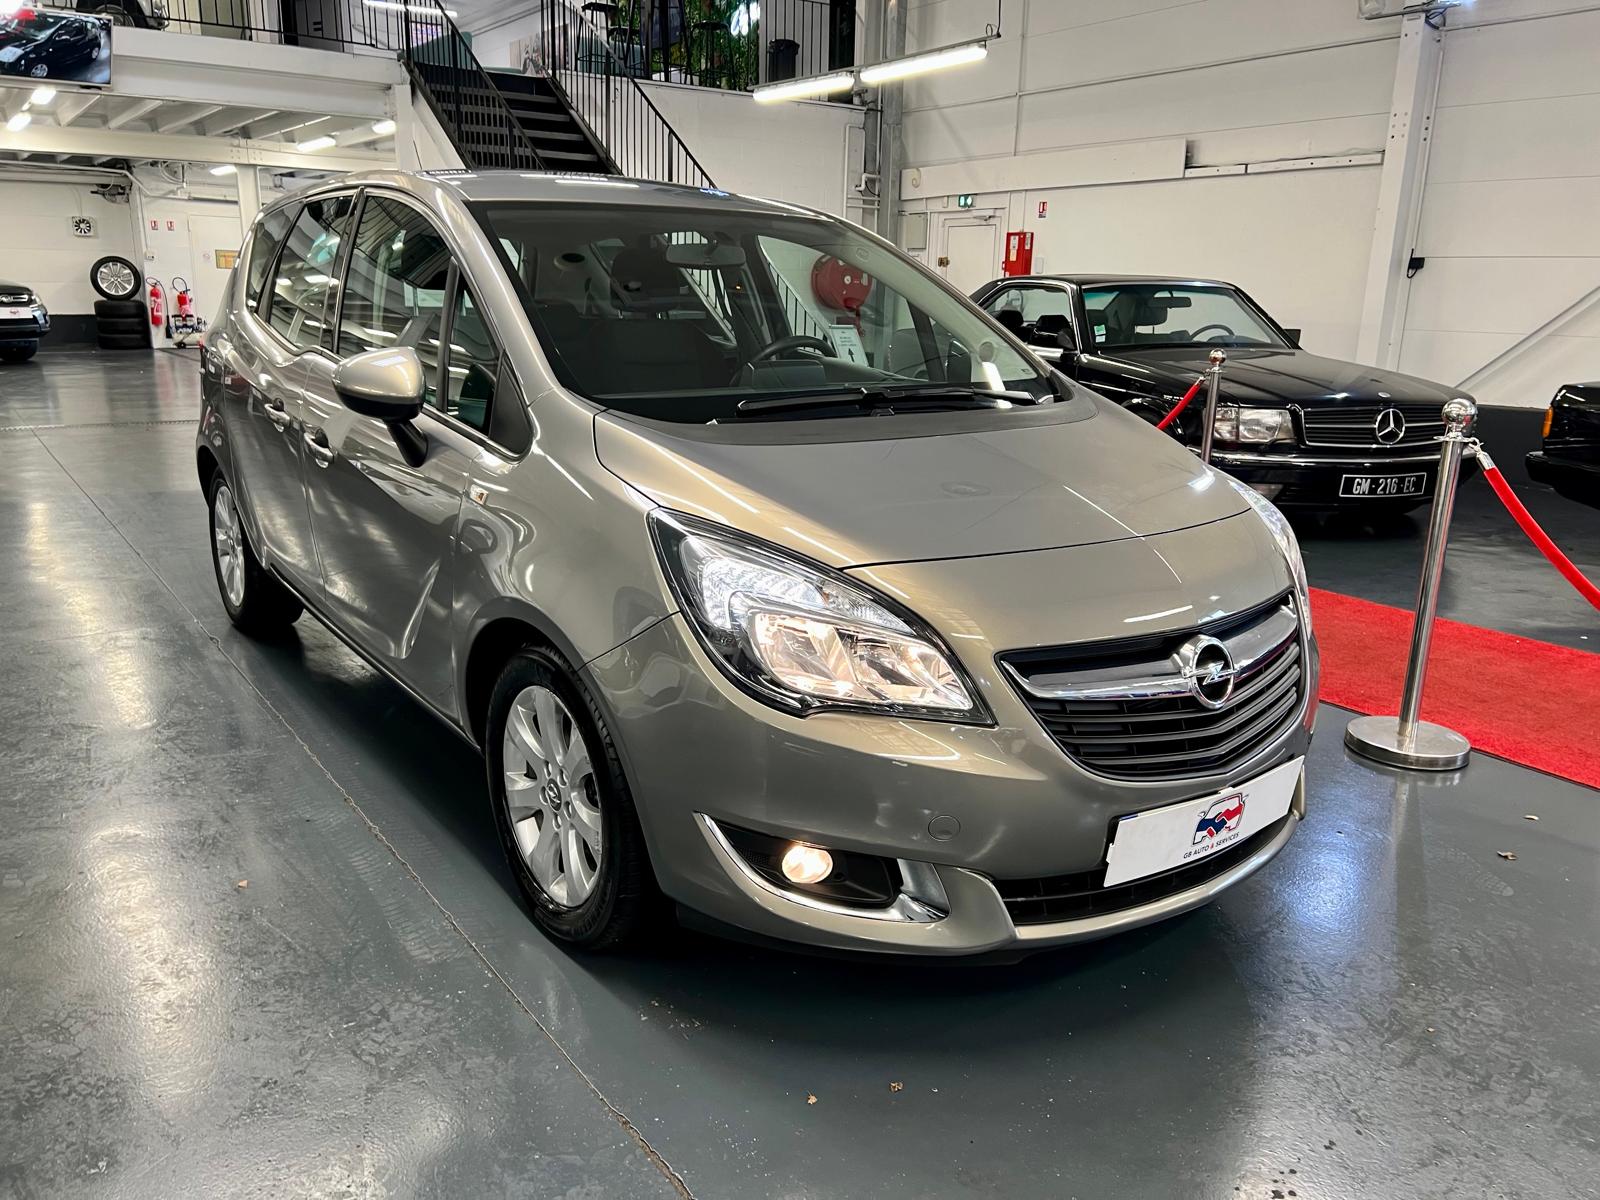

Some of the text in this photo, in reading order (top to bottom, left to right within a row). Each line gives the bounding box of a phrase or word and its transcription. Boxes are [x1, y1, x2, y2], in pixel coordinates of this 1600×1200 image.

[1183, 851, 1192, 859] GB
[1193, 845, 1210, 855] AUTO
[1216, 832, 1240, 847] SERVICES
